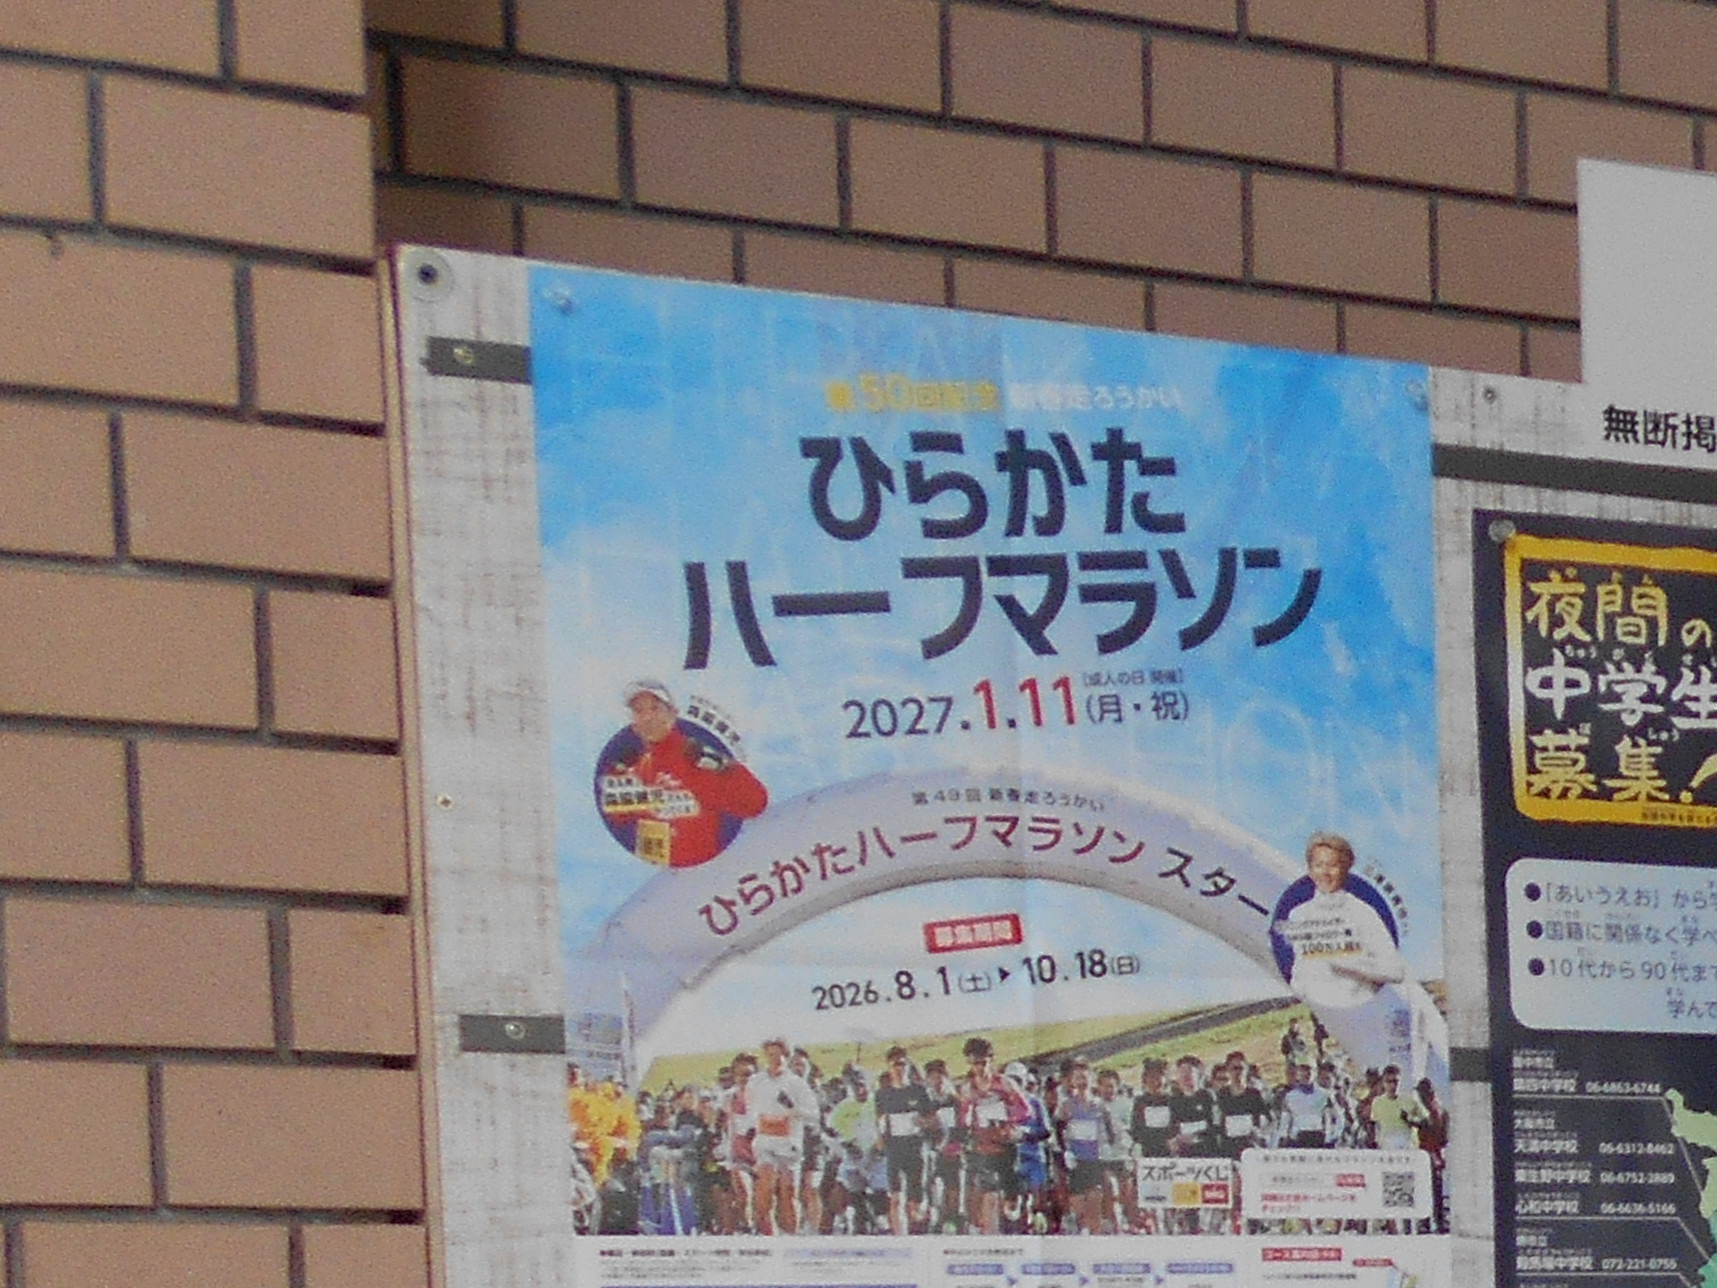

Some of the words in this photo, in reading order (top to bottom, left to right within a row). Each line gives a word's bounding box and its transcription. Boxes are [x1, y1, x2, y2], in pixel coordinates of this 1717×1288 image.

[801, 426, 1187, 542] ひらかた
[683, 547, 1323, 670] ハーフマラソン
[1525, 570, 1714, 648] 夜間の
[697, 814, 1146, 938] ひらかたハーフマラソン
[1142, 1163, 1229, 1182] スポーツくじ
